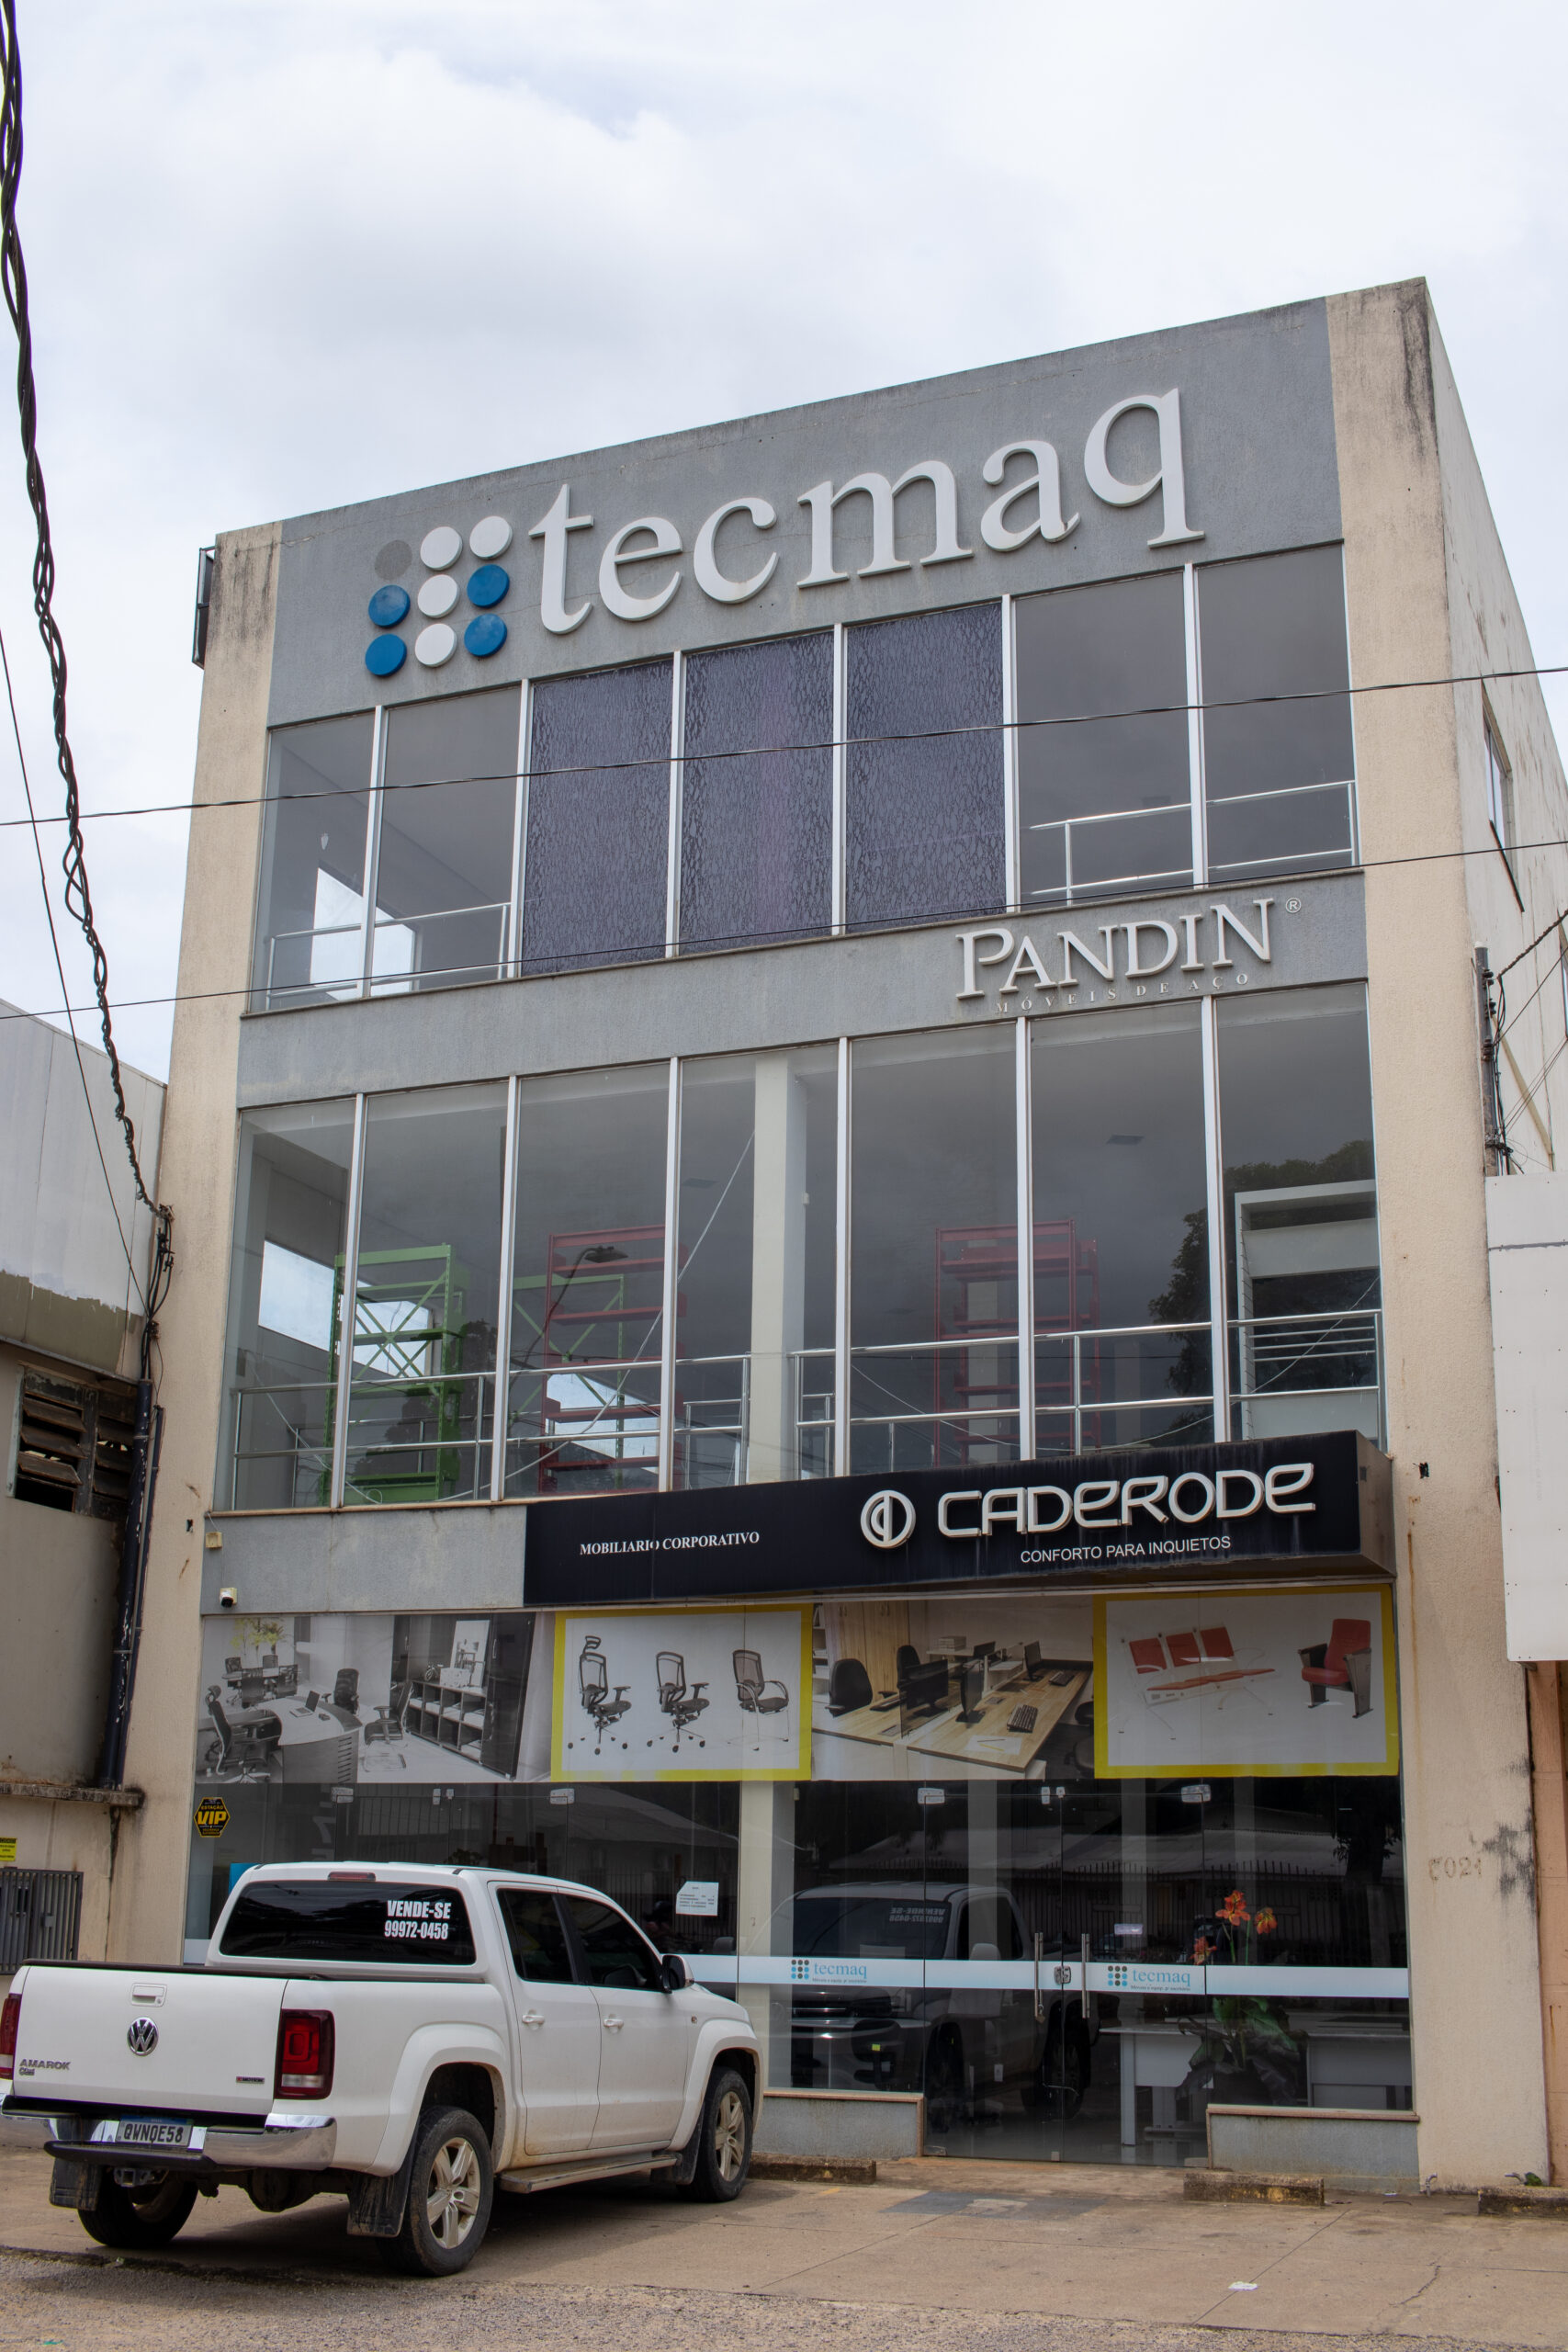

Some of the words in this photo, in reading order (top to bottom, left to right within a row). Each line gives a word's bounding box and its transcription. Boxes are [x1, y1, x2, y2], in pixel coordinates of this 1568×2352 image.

[528, 387, 1205, 636] tecmaq
[955, 898, 1274, 1000] PANDIN
[996, 986, 1117, 1014] MÓVEIS
[1136, 982, 1169, 997] DE
[1189, 973, 1248, 991] AÇO
[580, 1539, 660, 1555] MOBILIARIO
[662, 1532, 760, 1550] CORPORATIVO
[1021, 1546, 1102, 1563] CONFORTO
[1106, 1544, 1145, 1557] PARA
[1149, 1536, 1231, 1555] INQUIETOS
[197, 1811, 227, 1825] VIP
[388, 1900, 452, 1919] VENDE-SE
[384, 1920, 449, 1939] 99972-0458
[814, 1962, 867, 1979] tecmaq
[1133, 1970, 1190, 1986] tecmaq
[19, 2058, 71, 2071] AMAROK
